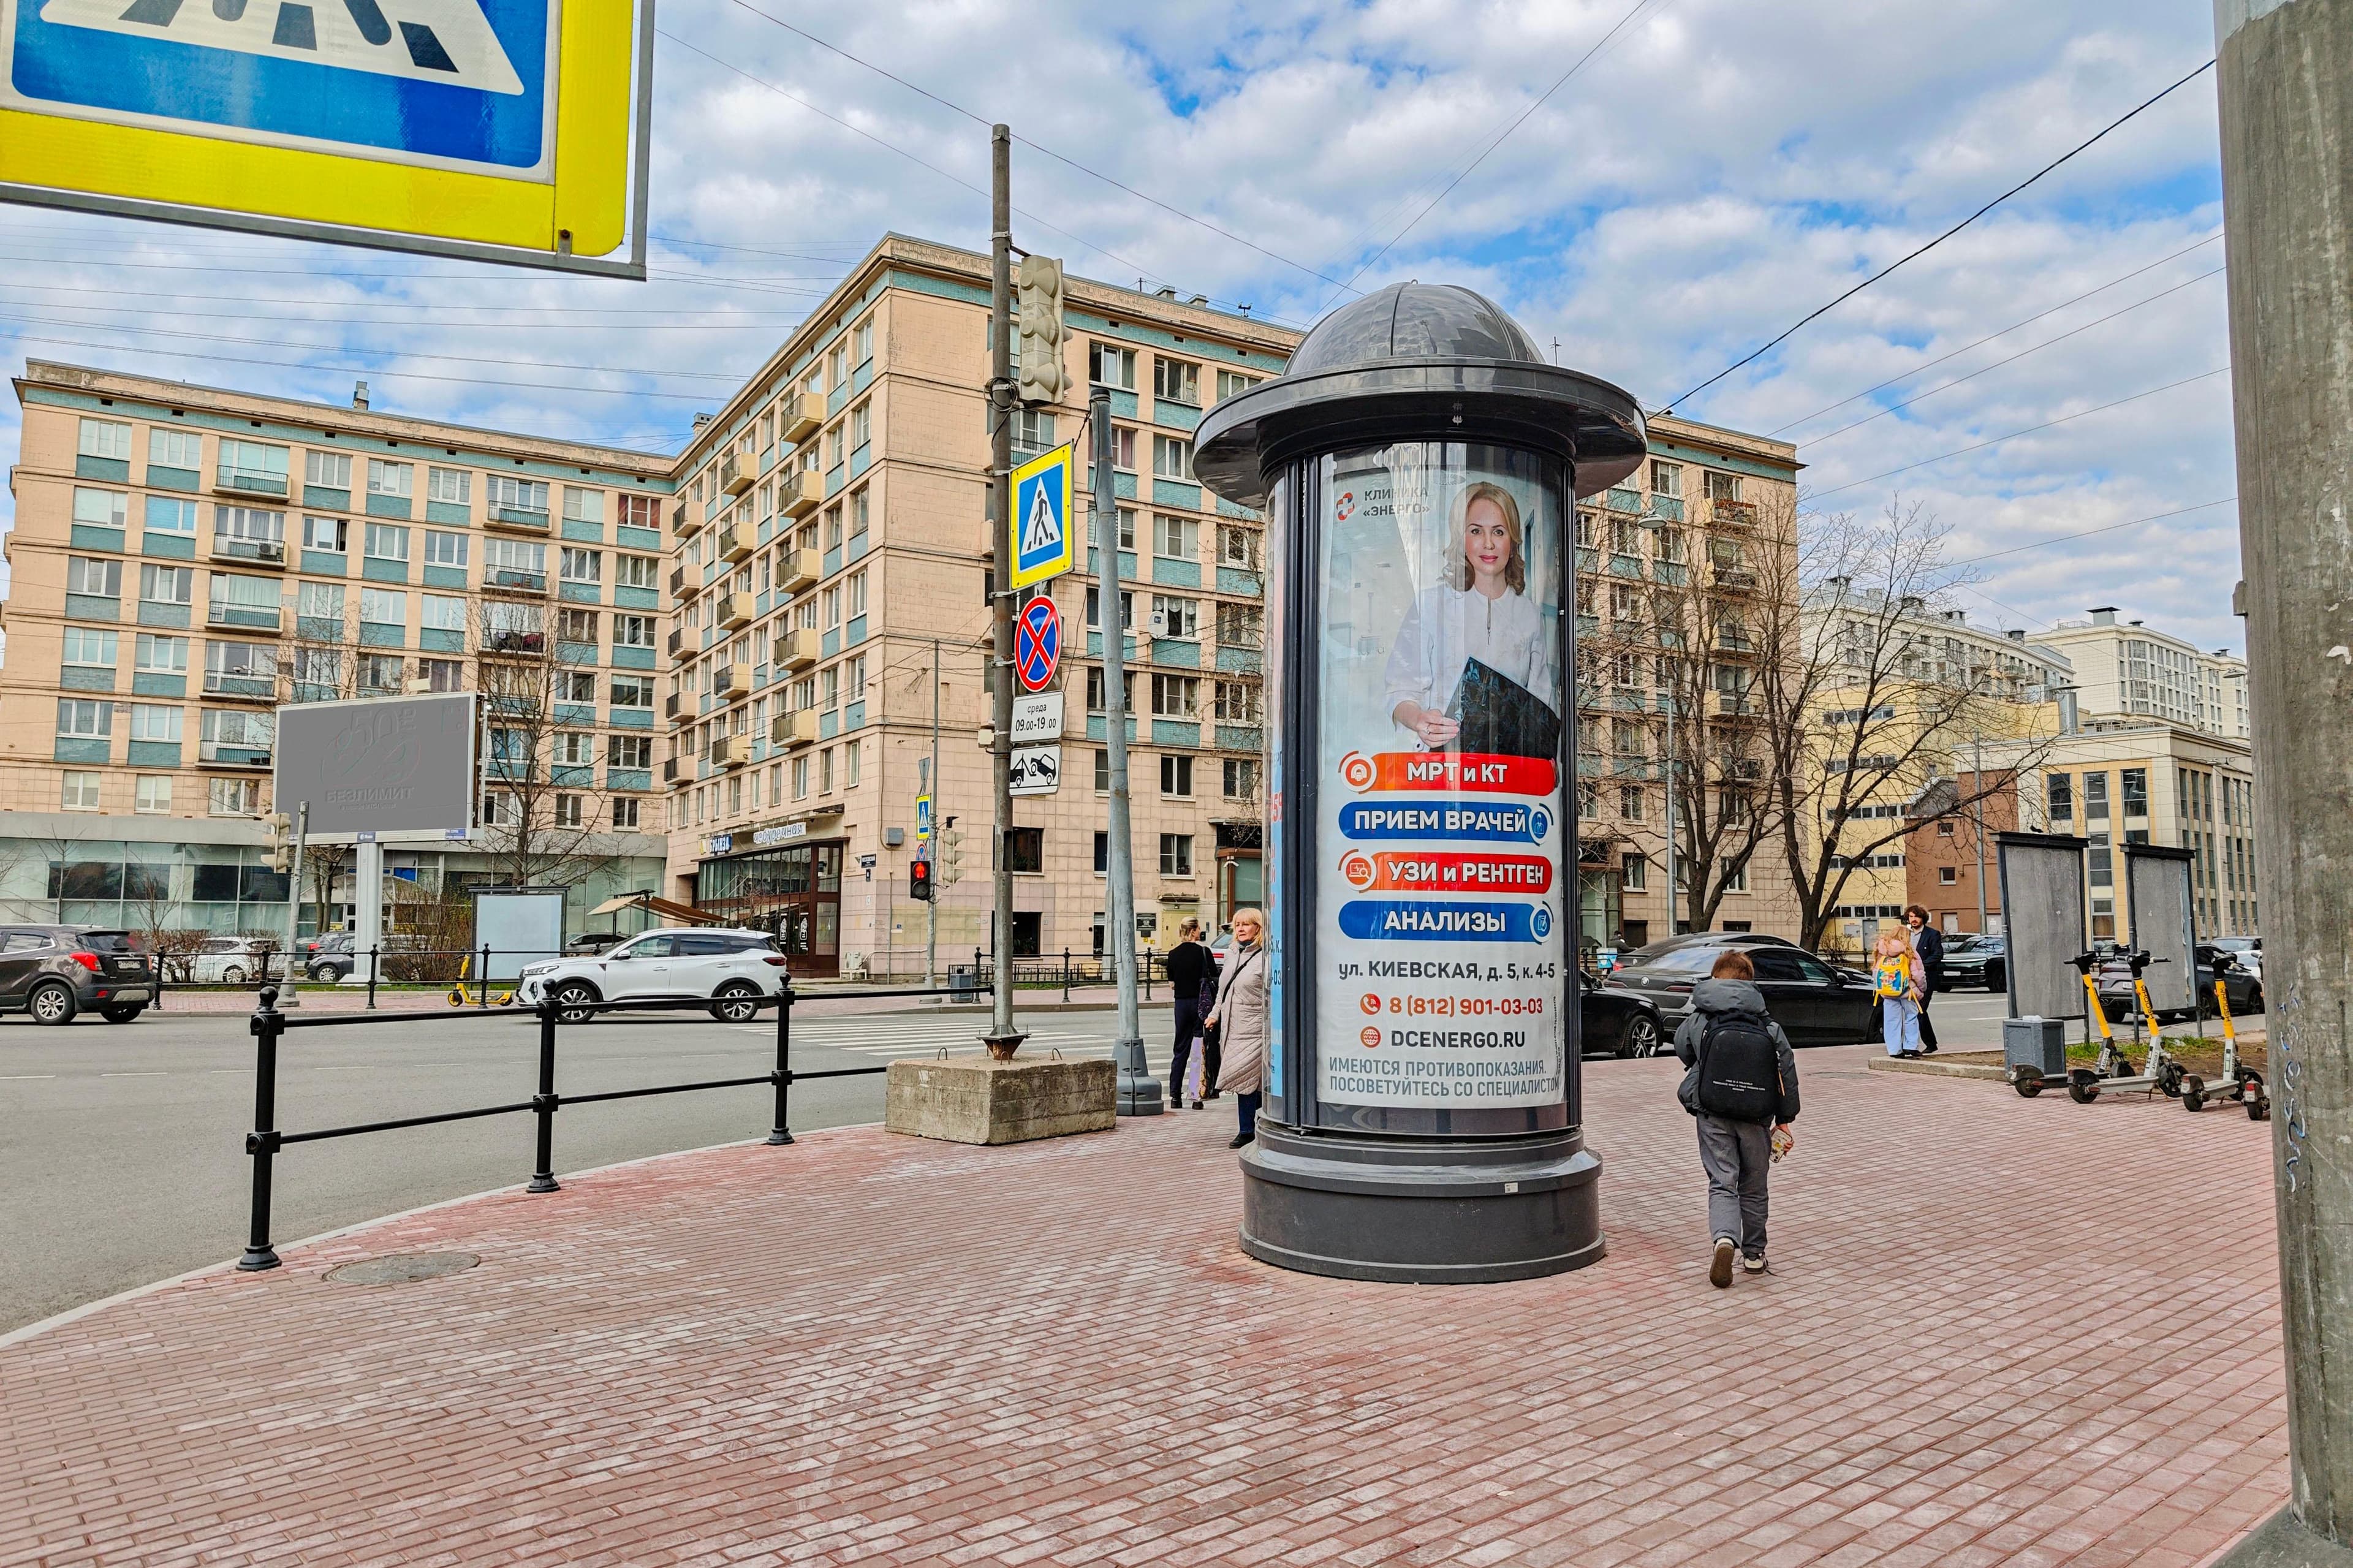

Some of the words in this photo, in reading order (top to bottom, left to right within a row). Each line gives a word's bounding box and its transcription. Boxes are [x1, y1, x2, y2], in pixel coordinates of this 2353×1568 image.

[1364, 487, 1428, 501] КЛИНИКА
[1363, 503, 1431, 517] «ЭНЕРГО»
[1027, 704, 1047, 715] среда
[1407, 761, 1459, 781] МРТ
[1463, 767, 1477, 782] и
[1481, 763, 1508, 783] КТ
[1354, 810, 1439, 830] ПРИЕМ
[1445, 808, 1526, 832] ВРАЧЕЙ
[754, 824, 803, 844] чебуречная
[1387, 861, 1438, 881] УЗИ
[1443, 865, 1457, 882] и
[1462, 862, 1544, 884] РЕНТГЕН
[1384, 911, 1506, 932] АНАЛИЗЫ
[1339, 963, 1363, 980] ул.
[1368, 961, 1483, 982] КИЕВСКАЯ,
[1487, 966, 1502, 982] д.
[1507, 963, 1520, 982] 5,
[1523, 966, 1533, 979] к.
[1536, 963, 1556, 979] 4-5
[1389, 997, 1402, 1013] 8
[1408, 994, 1455, 1018] (812)
[1460, 998, 1543, 1015] 901-03-03
[2141, 985, 2154, 1019] WHOOSH
[1391, 1030, 1526, 1048] DCENERGO.RU
[1329, 1057, 1400, 1076] ИМЕЮТСЯ
[1405, 1059, 1547, 1077] ПРОТИВОПОКАЗАНИЯ.
[1330, 1075, 1450, 1097] ПОСОВЕТУЙТЕСЬ
[1454, 1081, 1473, 1097] СО
[1477, 1077, 1559, 1098] СПЕЦИАЛИСТОМ
